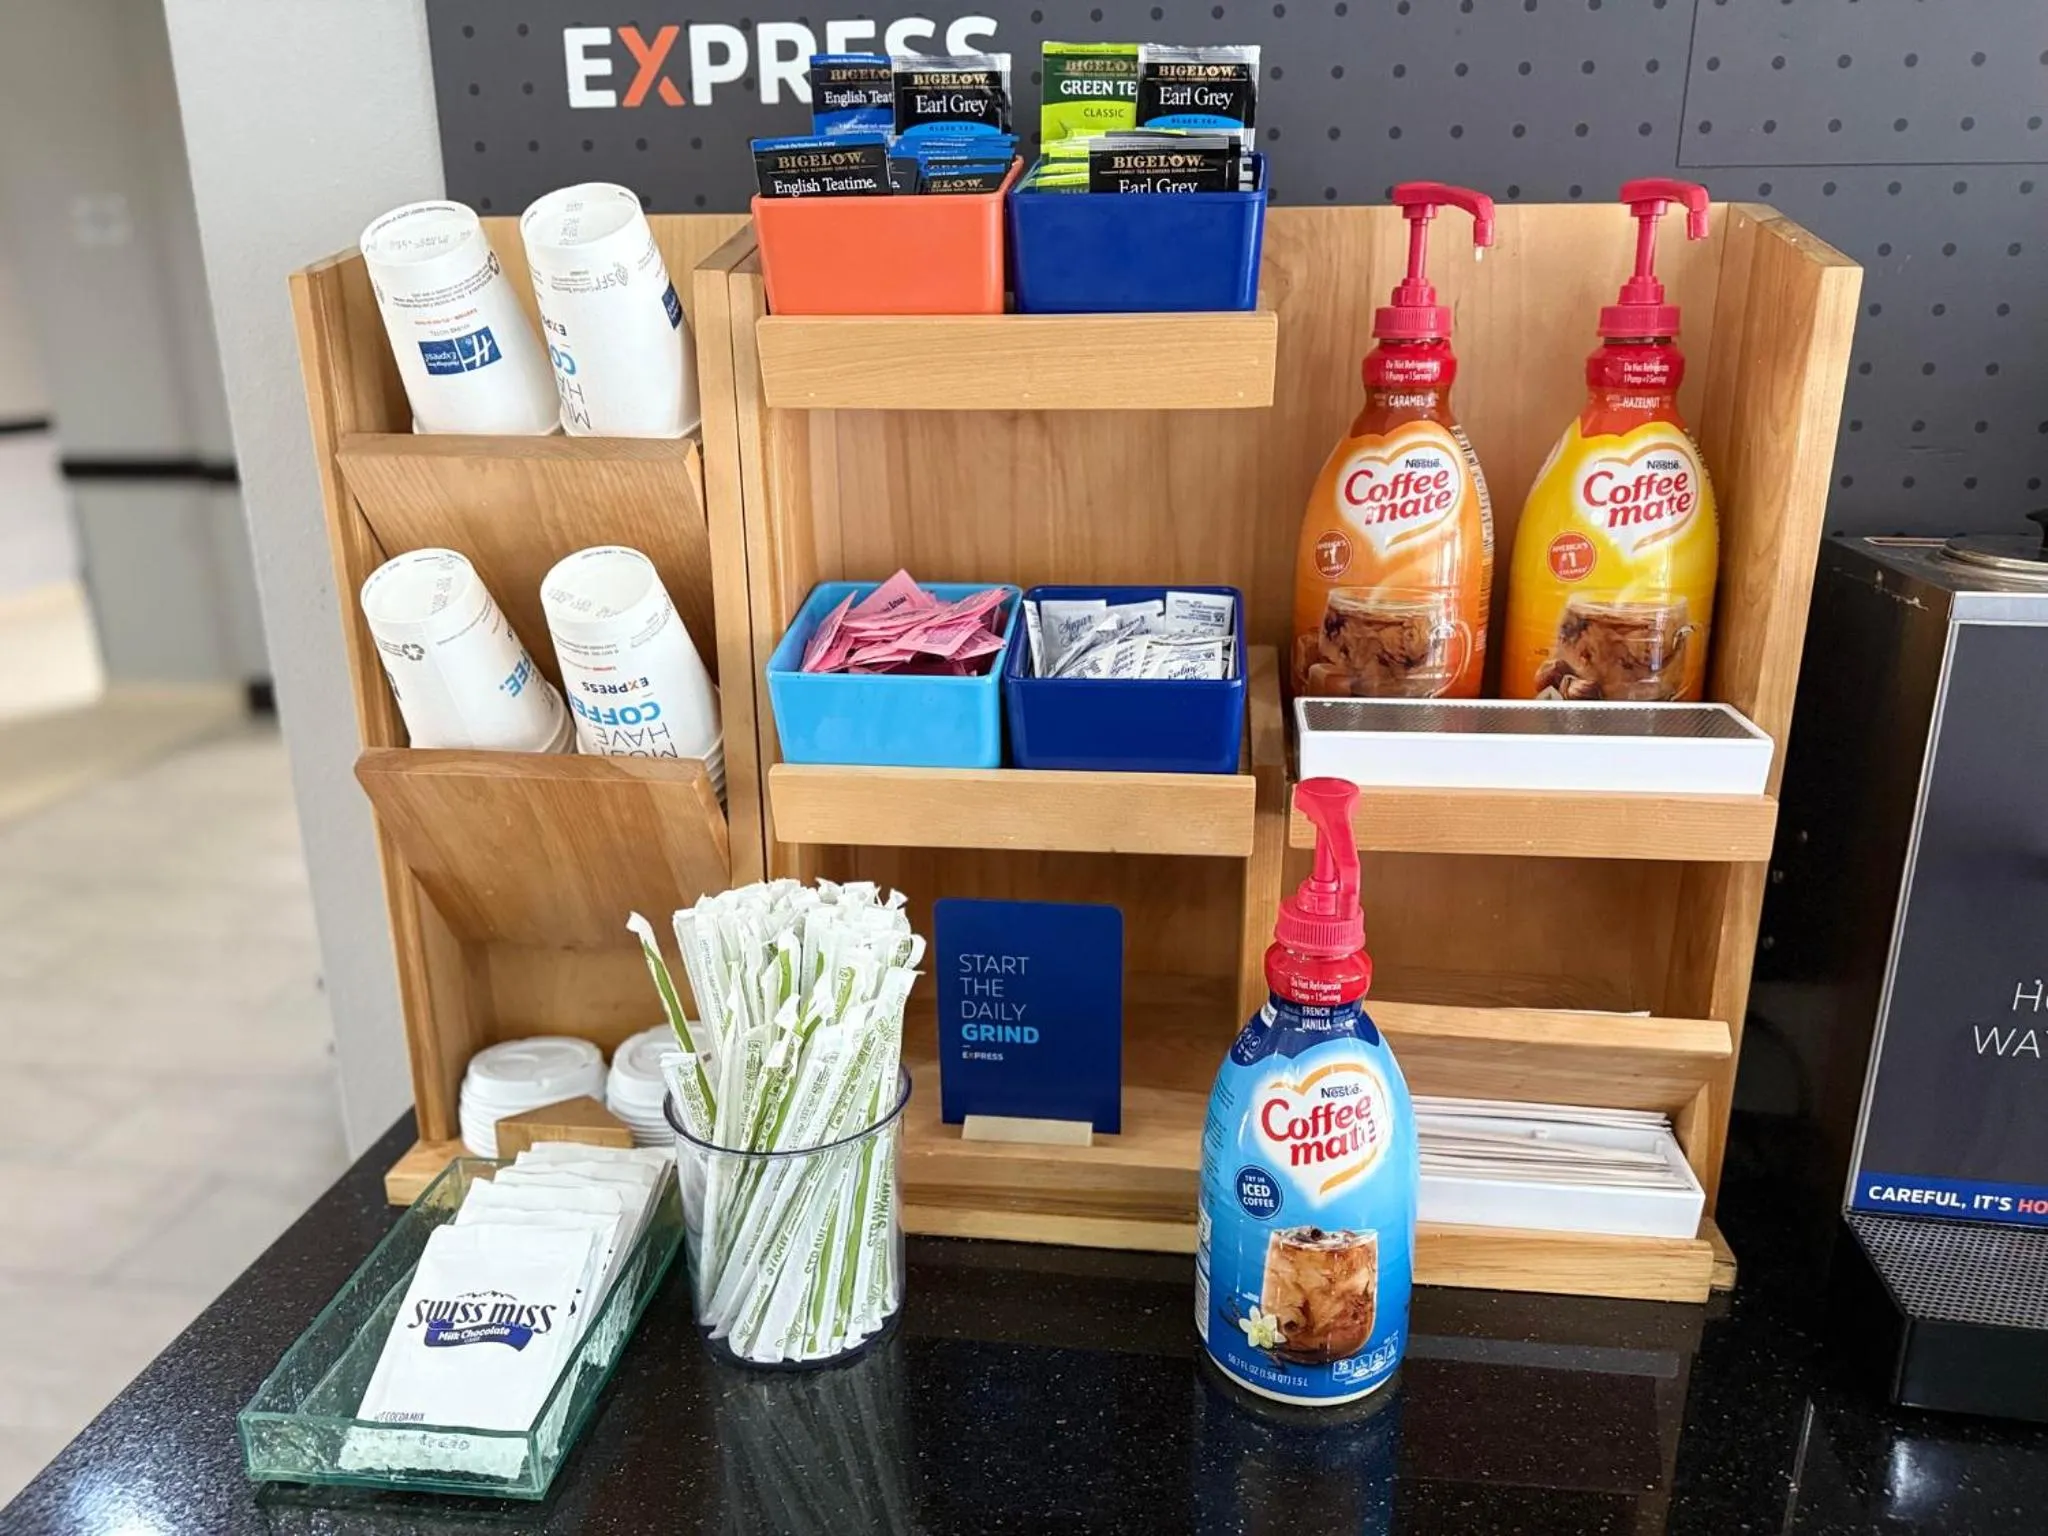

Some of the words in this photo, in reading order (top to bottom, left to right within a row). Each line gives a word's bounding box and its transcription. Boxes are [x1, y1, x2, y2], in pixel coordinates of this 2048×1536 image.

[831, 68, 891, 81] BIGELO
[1060, 79, 1114, 96] GREEN
[1116, 81, 1137, 96] TE
[824, 90, 867, 108] English
[868, 90, 893, 104] Teat
[915, 94, 948, 114] Earl
[949, 93, 988, 117] Grey
[1159, 86, 1192, 106] Earl
[1193, 86, 1234, 111] Grey
[1083, 107, 1125, 119] CLASSIC
[773, 177, 821, 197] English
[1388, 394, 1425, 408] CARAMEL
[1622, 396, 1660, 409] HAZELNUT
[1345, 469, 1449, 506] Coffee
[1583, 470, 1688, 508] Coffee
[1364, 489, 1452, 525] mate
[1608, 491, 1691, 528] mate
[582, 676, 650, 695] EXPRESS
[568, 690, 662, 726] COFFE
[959, 953, 1030, 976] START
[959, 976, 1005, 998] THE
[2012, 980, 2048, 1013] H
[960, 1000, 1027, 1021] DAILY
[1302, 1006, 1330, 1017] FRENCH
[961, 1023, 1040, 1044] GRIND
[1302, 1018, 1332, 1031] VANILLA
[1973, 1024, 2048, 1060] WA
[1261, 1095, 1372, 1142] Coffee
[1242, 1182, 1271, 1198] ICED
[1867, 1184, 1968, 1209] CAREFUL,
[1972, 1193, 2013, 1212] IT'S
[2017, 1198, 2048, 1215] HO
[1243, 1197, 1275, 1208] COFFEE
[437, 1331, 461, 1342] Milk
[460, 1325, 511, 1340] Chocolate
